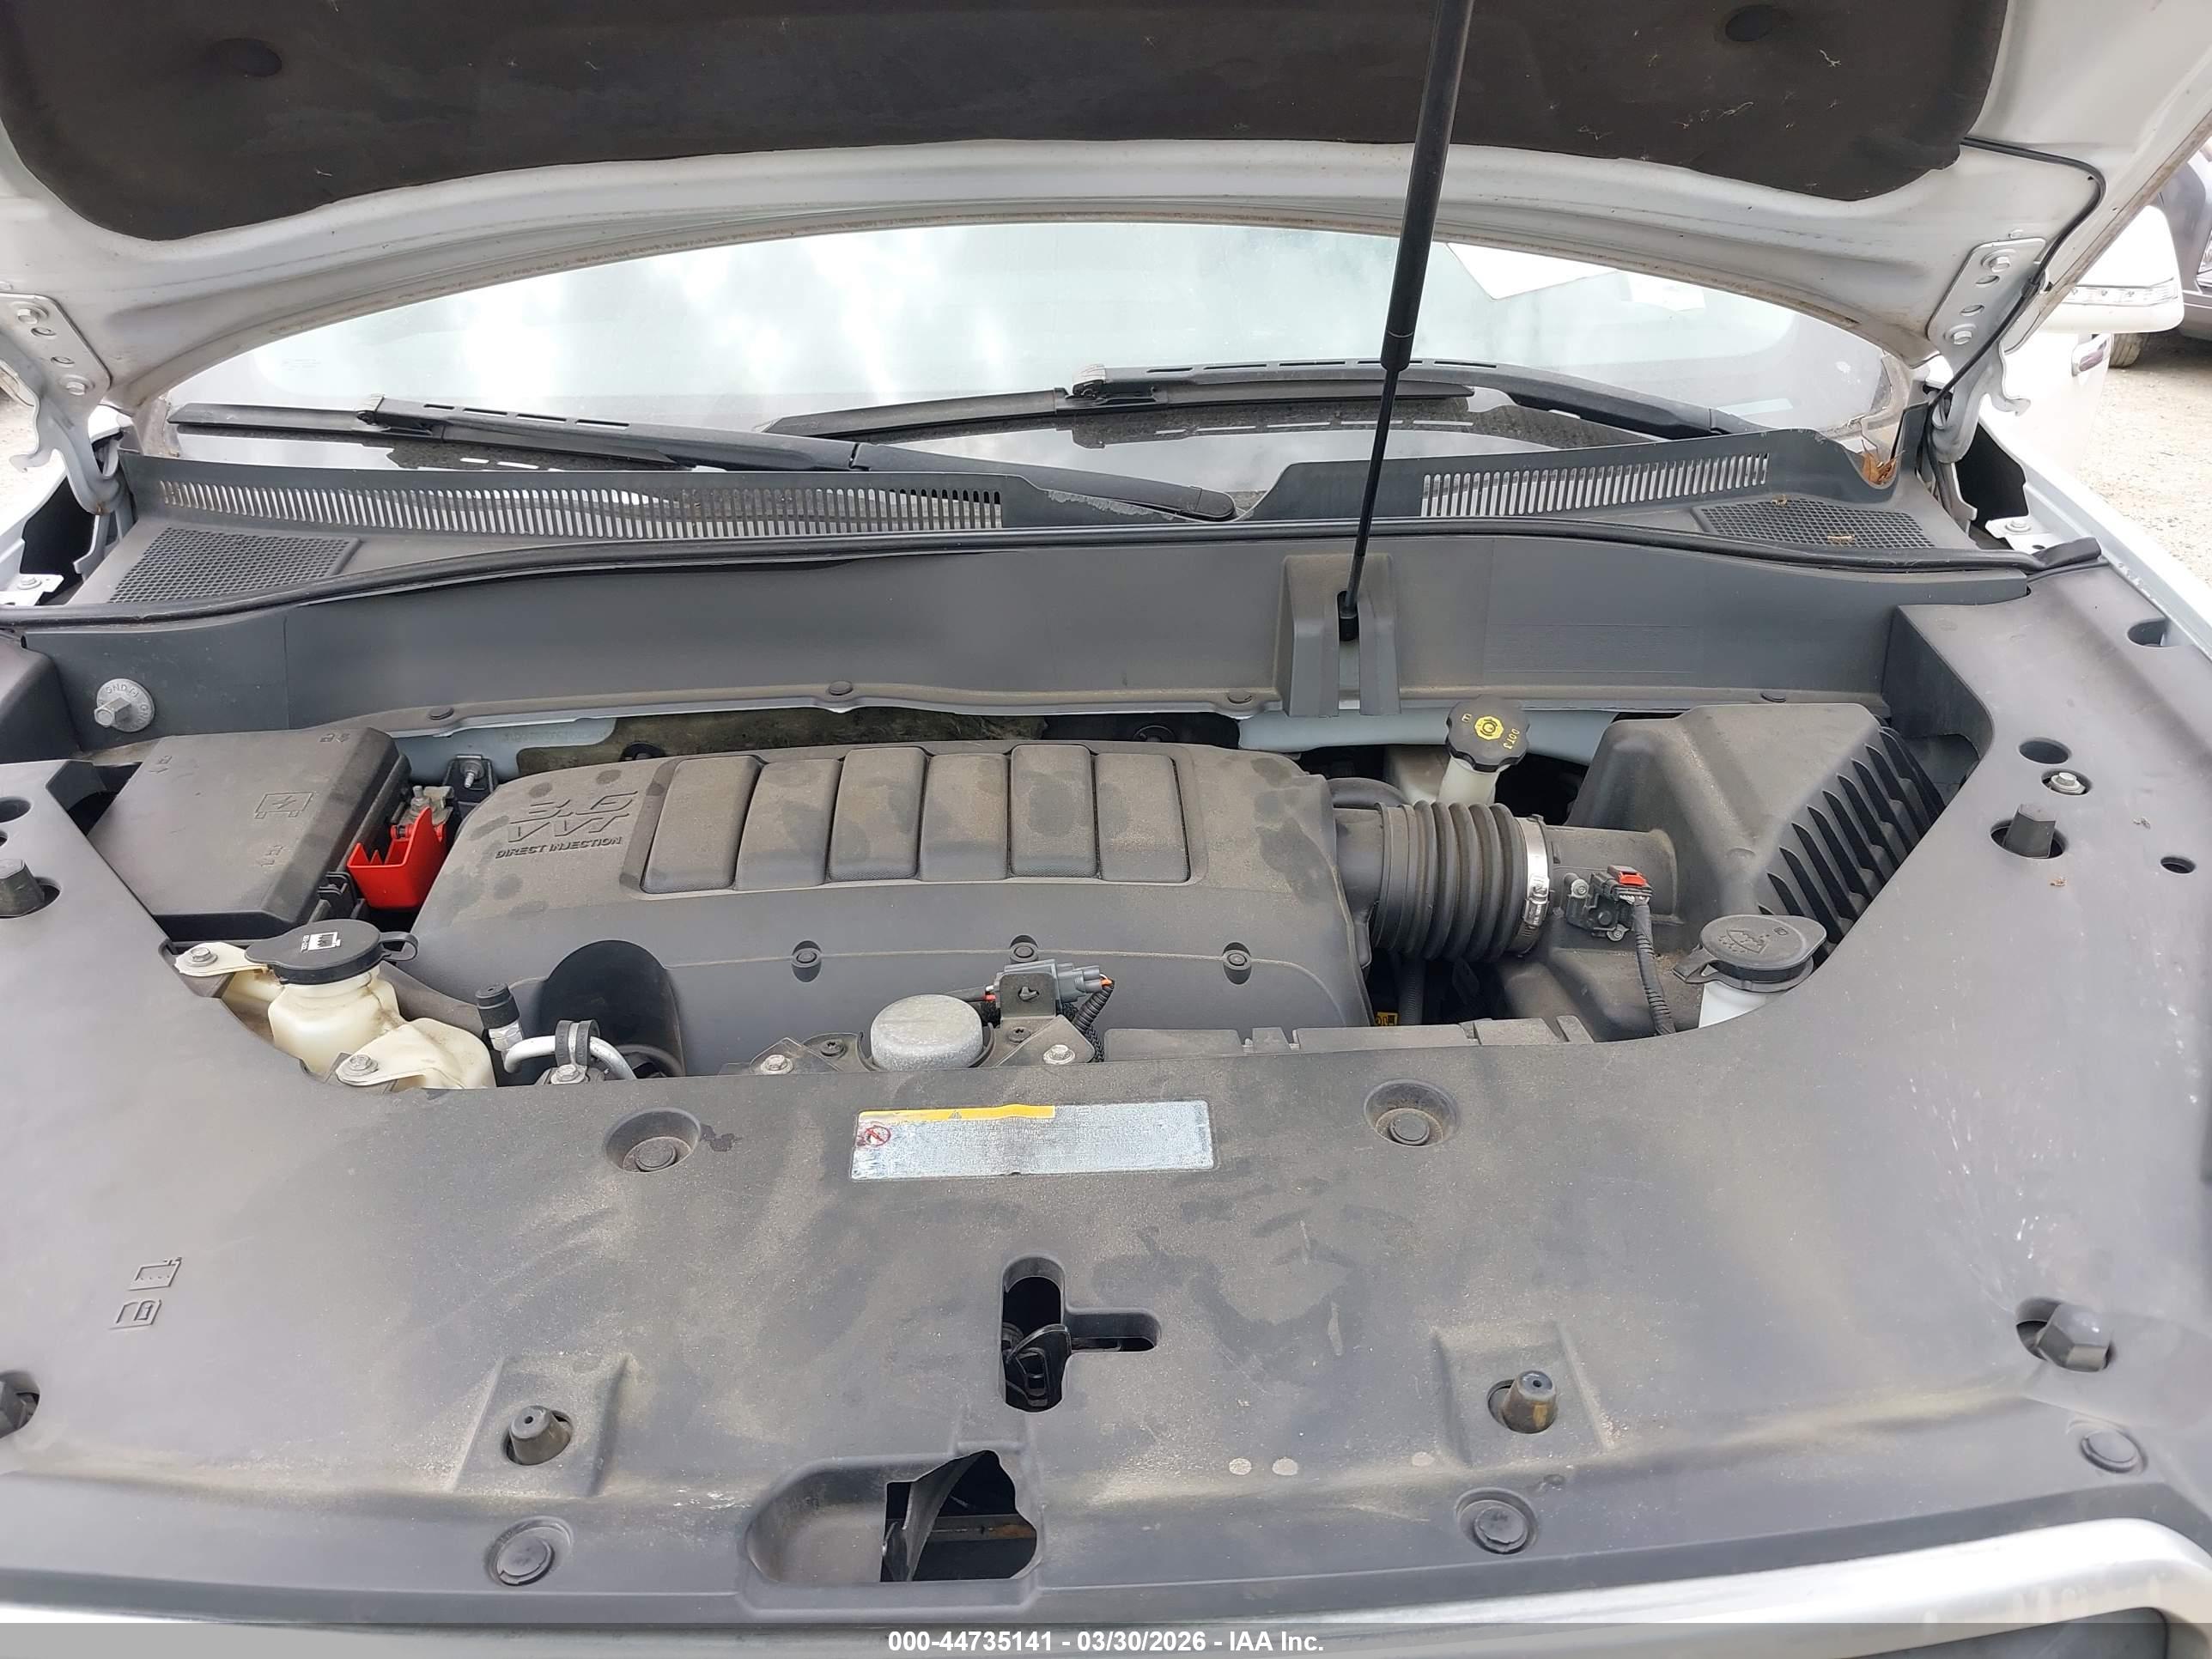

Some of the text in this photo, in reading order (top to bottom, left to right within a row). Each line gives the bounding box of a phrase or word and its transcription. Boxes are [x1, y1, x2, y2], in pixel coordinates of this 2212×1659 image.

[507, 812, 630, 844] VVT
[495, 836, 623, 860] DIRECT INJECTION
